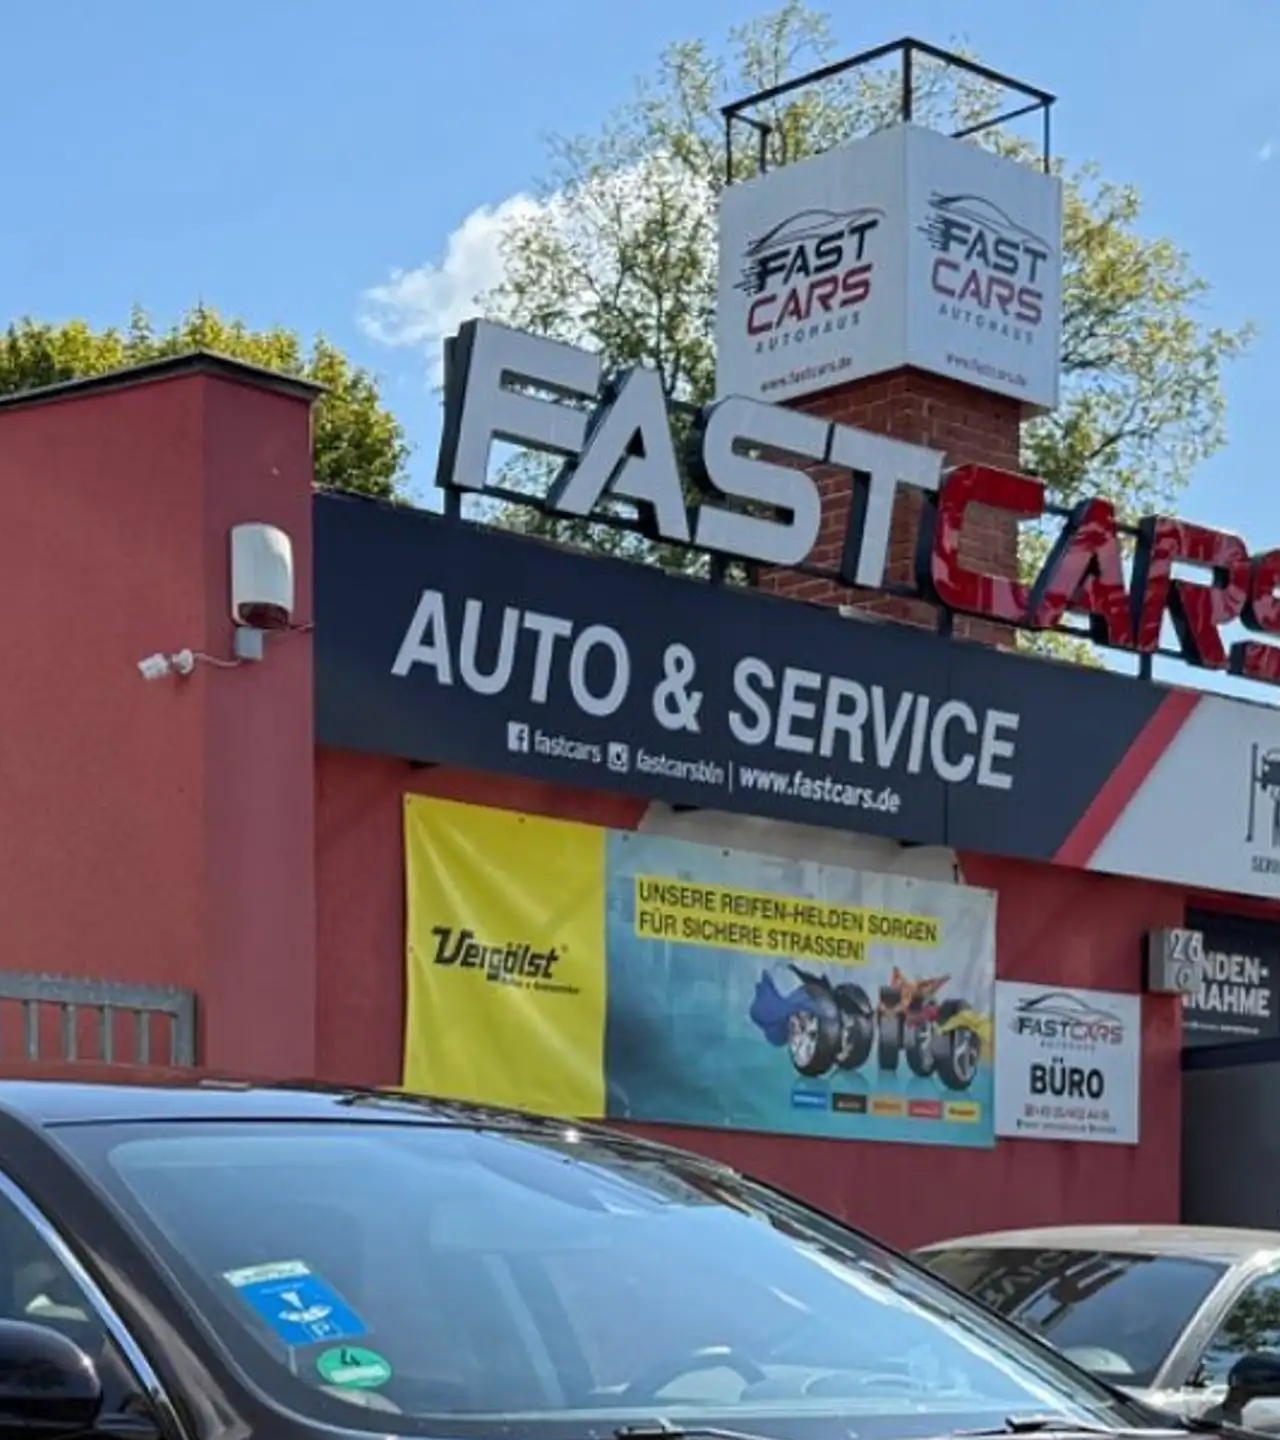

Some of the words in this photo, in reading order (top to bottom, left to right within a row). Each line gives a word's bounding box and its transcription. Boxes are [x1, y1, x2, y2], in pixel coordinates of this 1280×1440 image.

[756, 219, 880, 294] FAST
[938, 214, 1049, 284] FAST
[747, 263, 874, 337] CARS
[931, 257, 1044, 328] CARS
[937, 303, 1035, 345] AUTOHAUS
[755, 313, 862, 355] AUTOHAUS
[392, 588, 631, 717] AUTO
[652, 643, 704, 734] &
[728, 656, 1021, 790] SERVICE
[534, 729, 602, 765] fastcars
[739, 764, 902, 814] www.fastcars.de
[639, 880, 717, 912] UNSERE
[721, 892, 864, 934] REIFEN-HELDEN
[867, 912, 938, 943] SORGEN
[639, 908, 678, 936] FÜR
[682, 916, 763, 949] SICHERE
[767, 929, 865, 962] STRASSEN!
[431, 926, 560, 982] Vergölst
[1029, 1055, 1105, 1099] BÜRO
